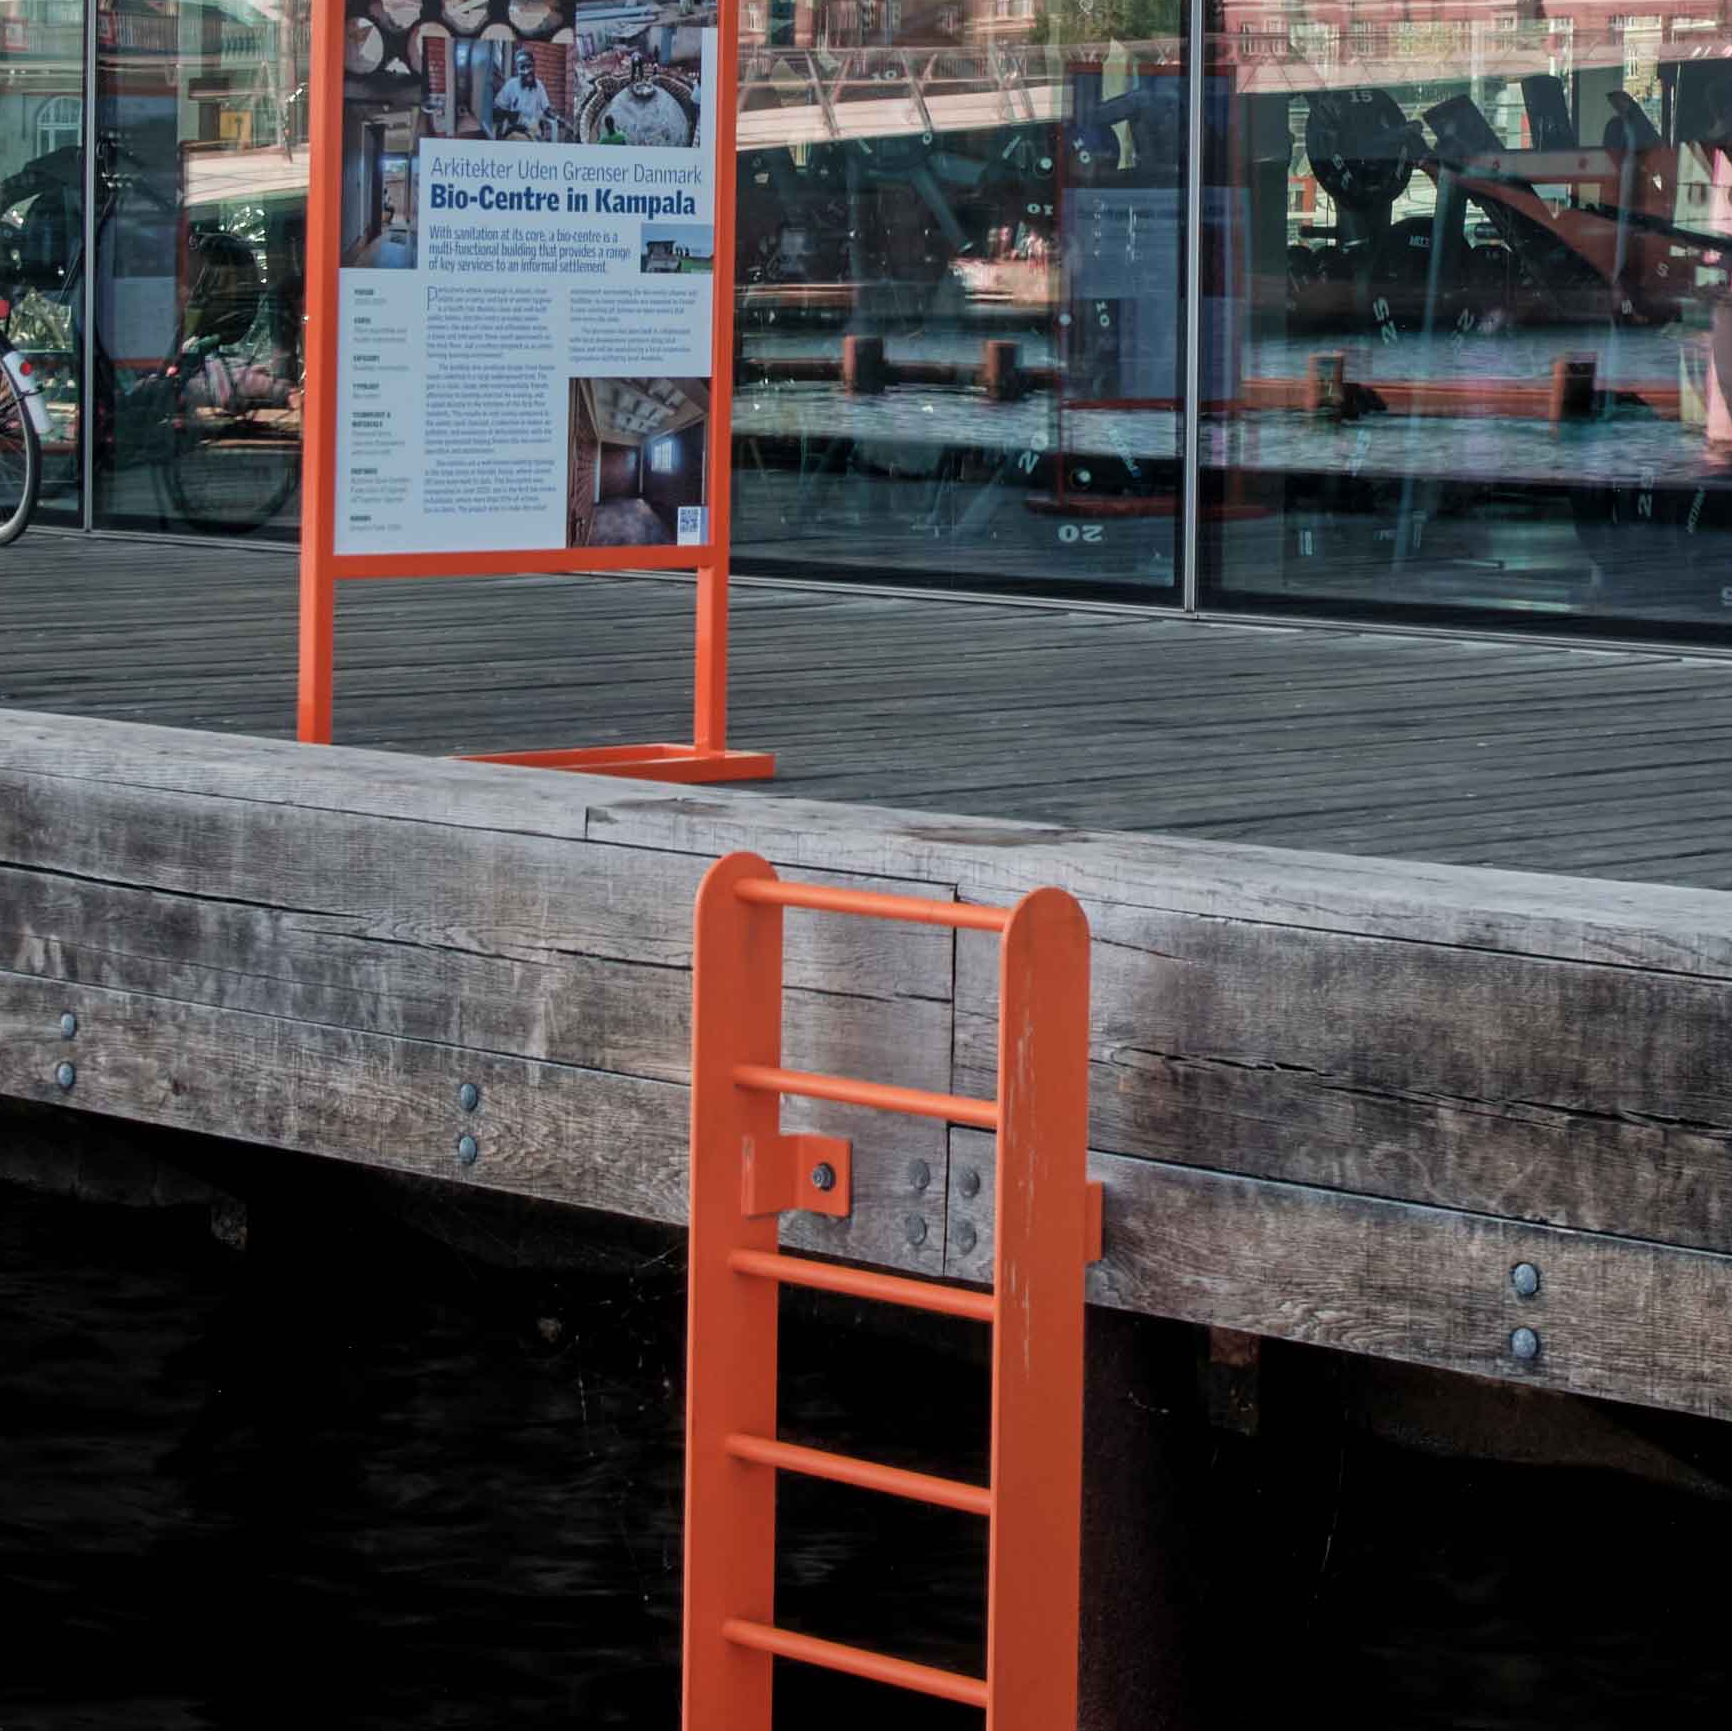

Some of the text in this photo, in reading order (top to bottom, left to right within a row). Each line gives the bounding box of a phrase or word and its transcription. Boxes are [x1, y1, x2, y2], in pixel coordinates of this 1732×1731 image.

[430, 156, 701, 185] Arkitekter Uden Grænser Danmark
[430, 183, 696, 220] Bio-Centre in Kampala
[429, 225, 452, 239] With
[455, 226, 498, 241] sanitation
[501, 229, 509, 241] at
[512, 228, 524, 241] its
[557, 228, 602, 243] bio-centre
[429, 241, 499, 257] multi-functional
[502, 242, 537, 261] building
[540, 243, 557, 257] that
[559, 244, 597, 261] provides
[606, 247, 631, 262] range
[429, 256, 607, 275] of key services to an informal settlement.
